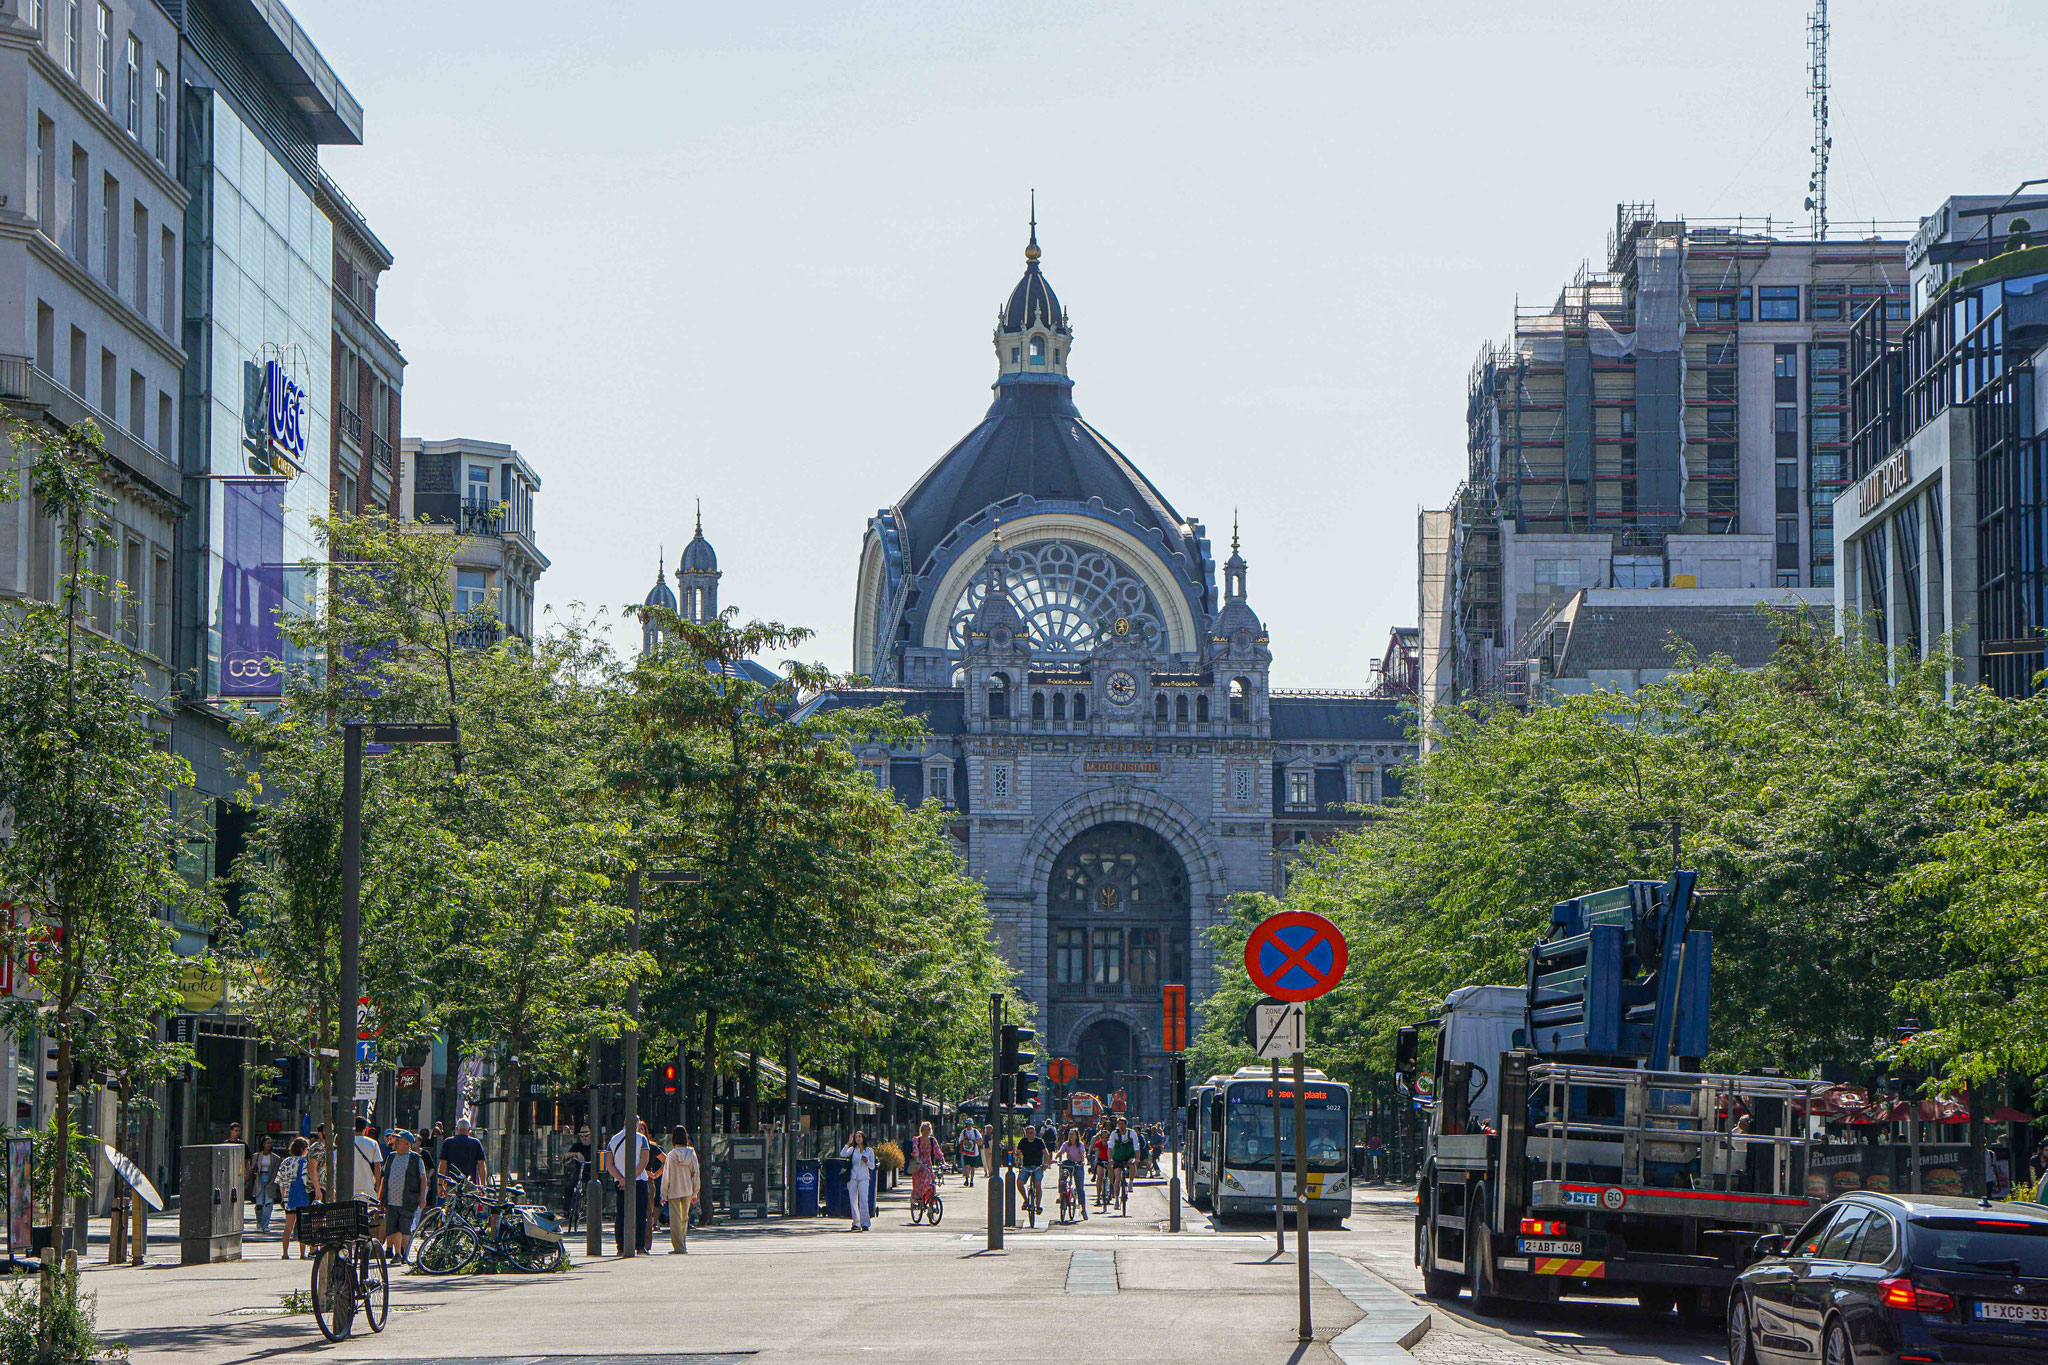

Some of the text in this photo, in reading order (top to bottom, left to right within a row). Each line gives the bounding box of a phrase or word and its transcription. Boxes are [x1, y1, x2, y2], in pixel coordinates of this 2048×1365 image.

[267, 360, 306, 458] UGC
[1858, 450, 1908, 517] HYLLIT HOTEL
[177, 1019, 186, 1080] waama
[1811, 1153, 1862, 1168] KLASSIEKERS
[1906, 1153, 1958, 1167] FRMIDABLE
[1573, 1194, 1596, 1204] CTE
[1608, 1192, 1621, 1202] 60
[1525, 1242, 1581, 1253] 2-ABT-048
